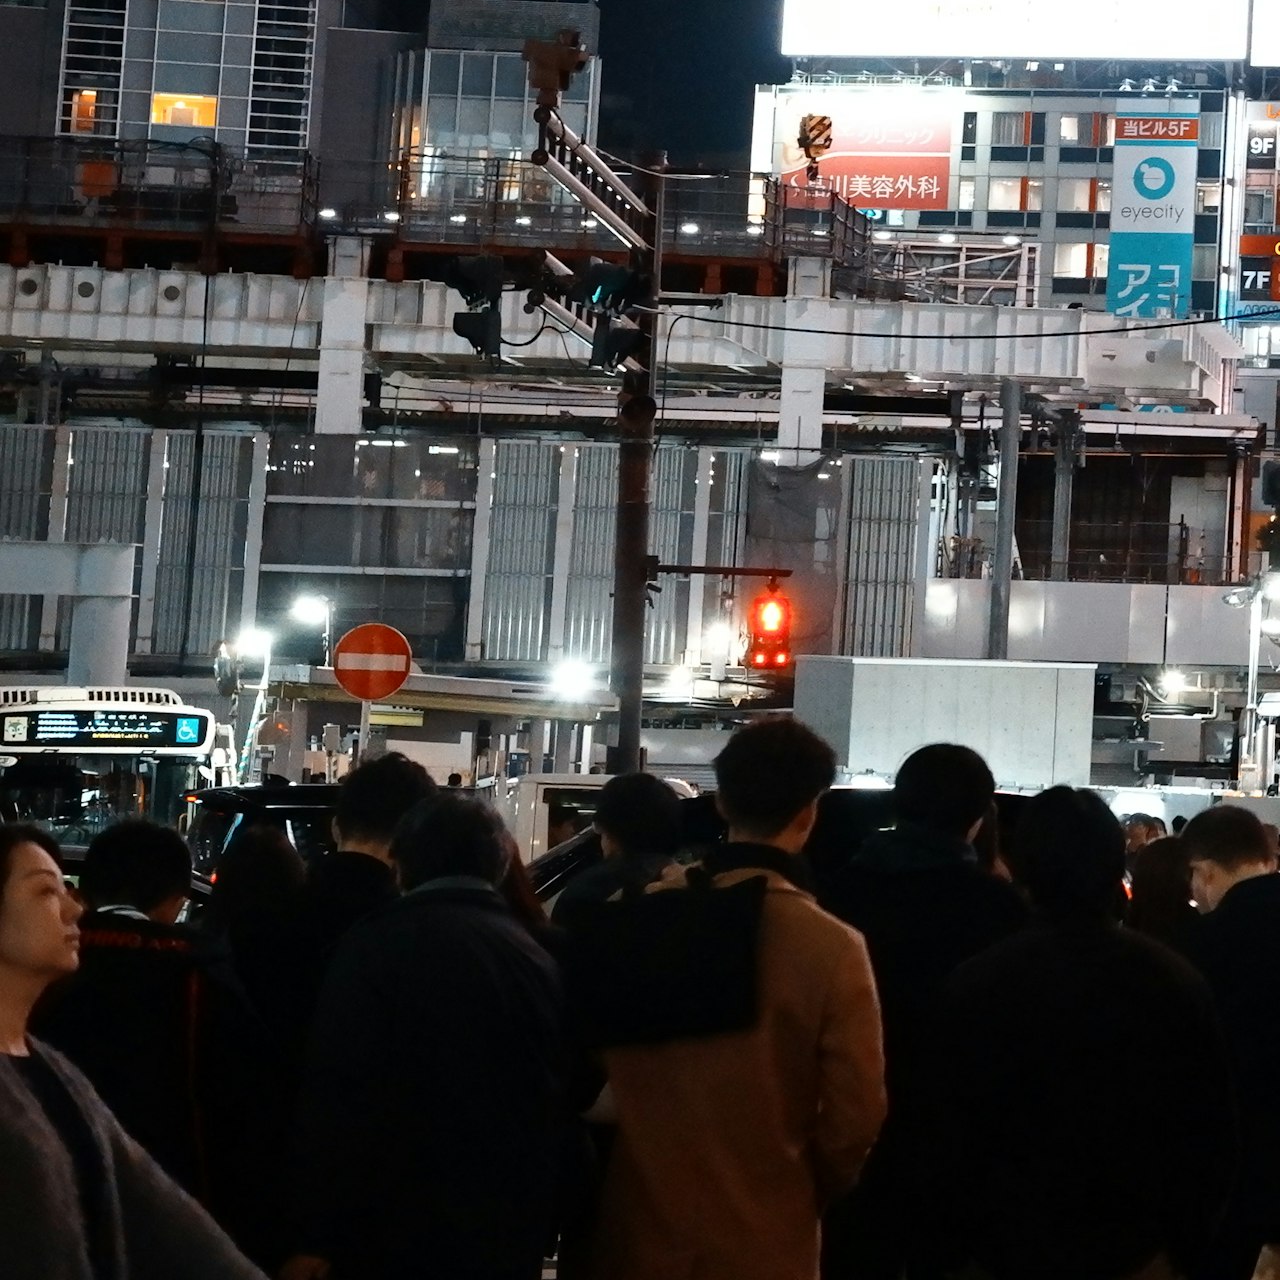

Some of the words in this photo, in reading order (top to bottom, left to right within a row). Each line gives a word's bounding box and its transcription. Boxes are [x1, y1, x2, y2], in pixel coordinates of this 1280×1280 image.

[1123, 120, 1191, 138] 当ビル5F
[1250, 137, 1275, 154] 9F
[1121, 204, 1184, 225] eyecity
[1243, 271, 1271, 290] 7F
